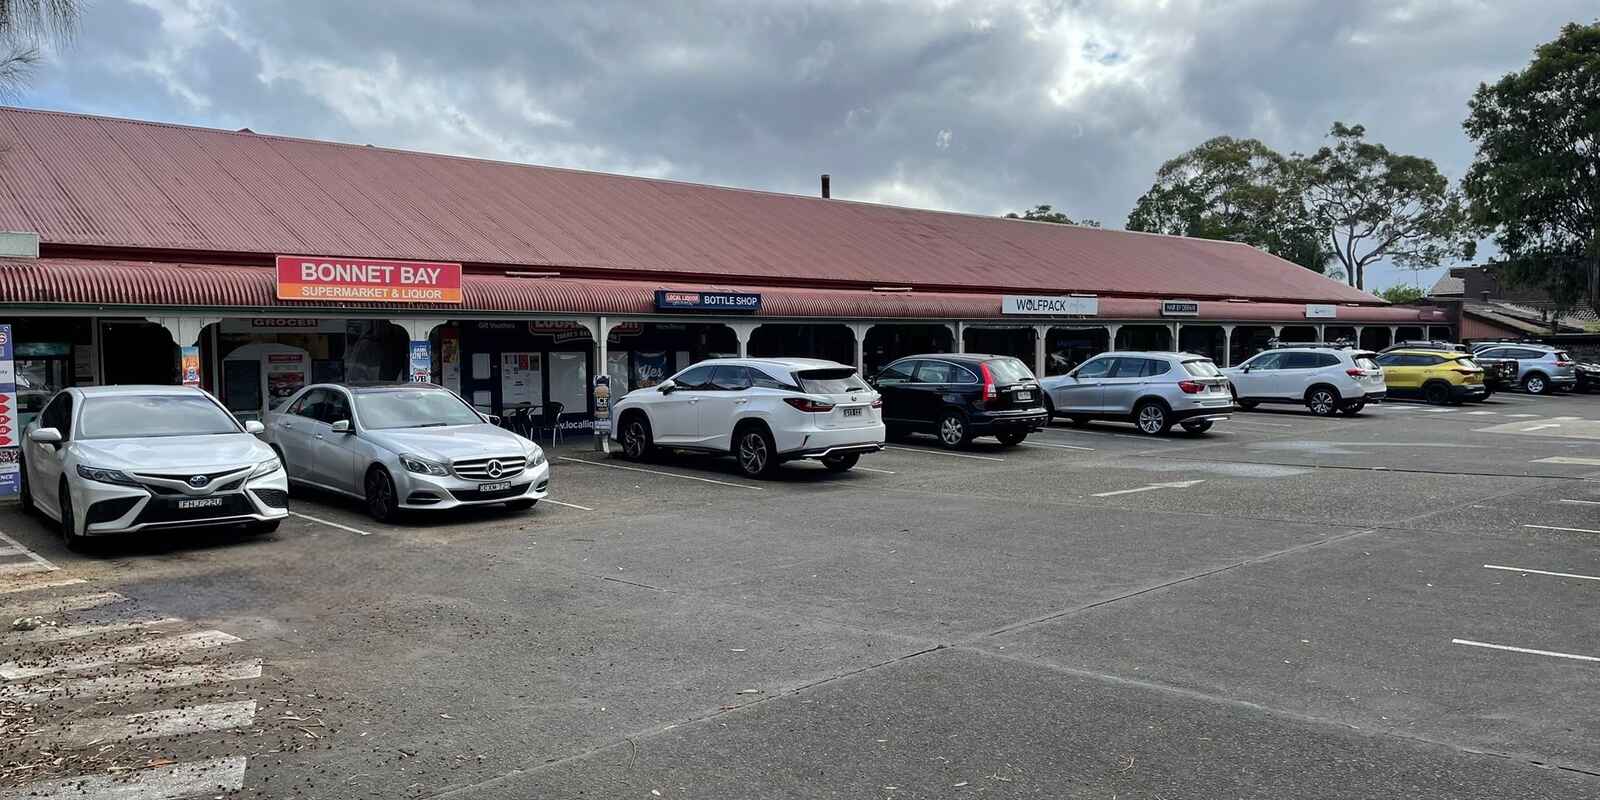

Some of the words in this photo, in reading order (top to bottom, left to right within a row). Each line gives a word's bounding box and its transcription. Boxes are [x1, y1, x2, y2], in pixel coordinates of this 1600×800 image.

[301, 262, 394, 284] BONNET
[400, 266, 441, 285] BAY
[302, 286, 390, 298] SUPERMARKET
[391, 289, 399, 298] &
[402, 288, 442, 299] LIQUOR
[704, 295, 735, 305] BOTTLE
[736, 296, 758, 305] SHOP
[1016, 298, 1066, 311] WOLFPACK
